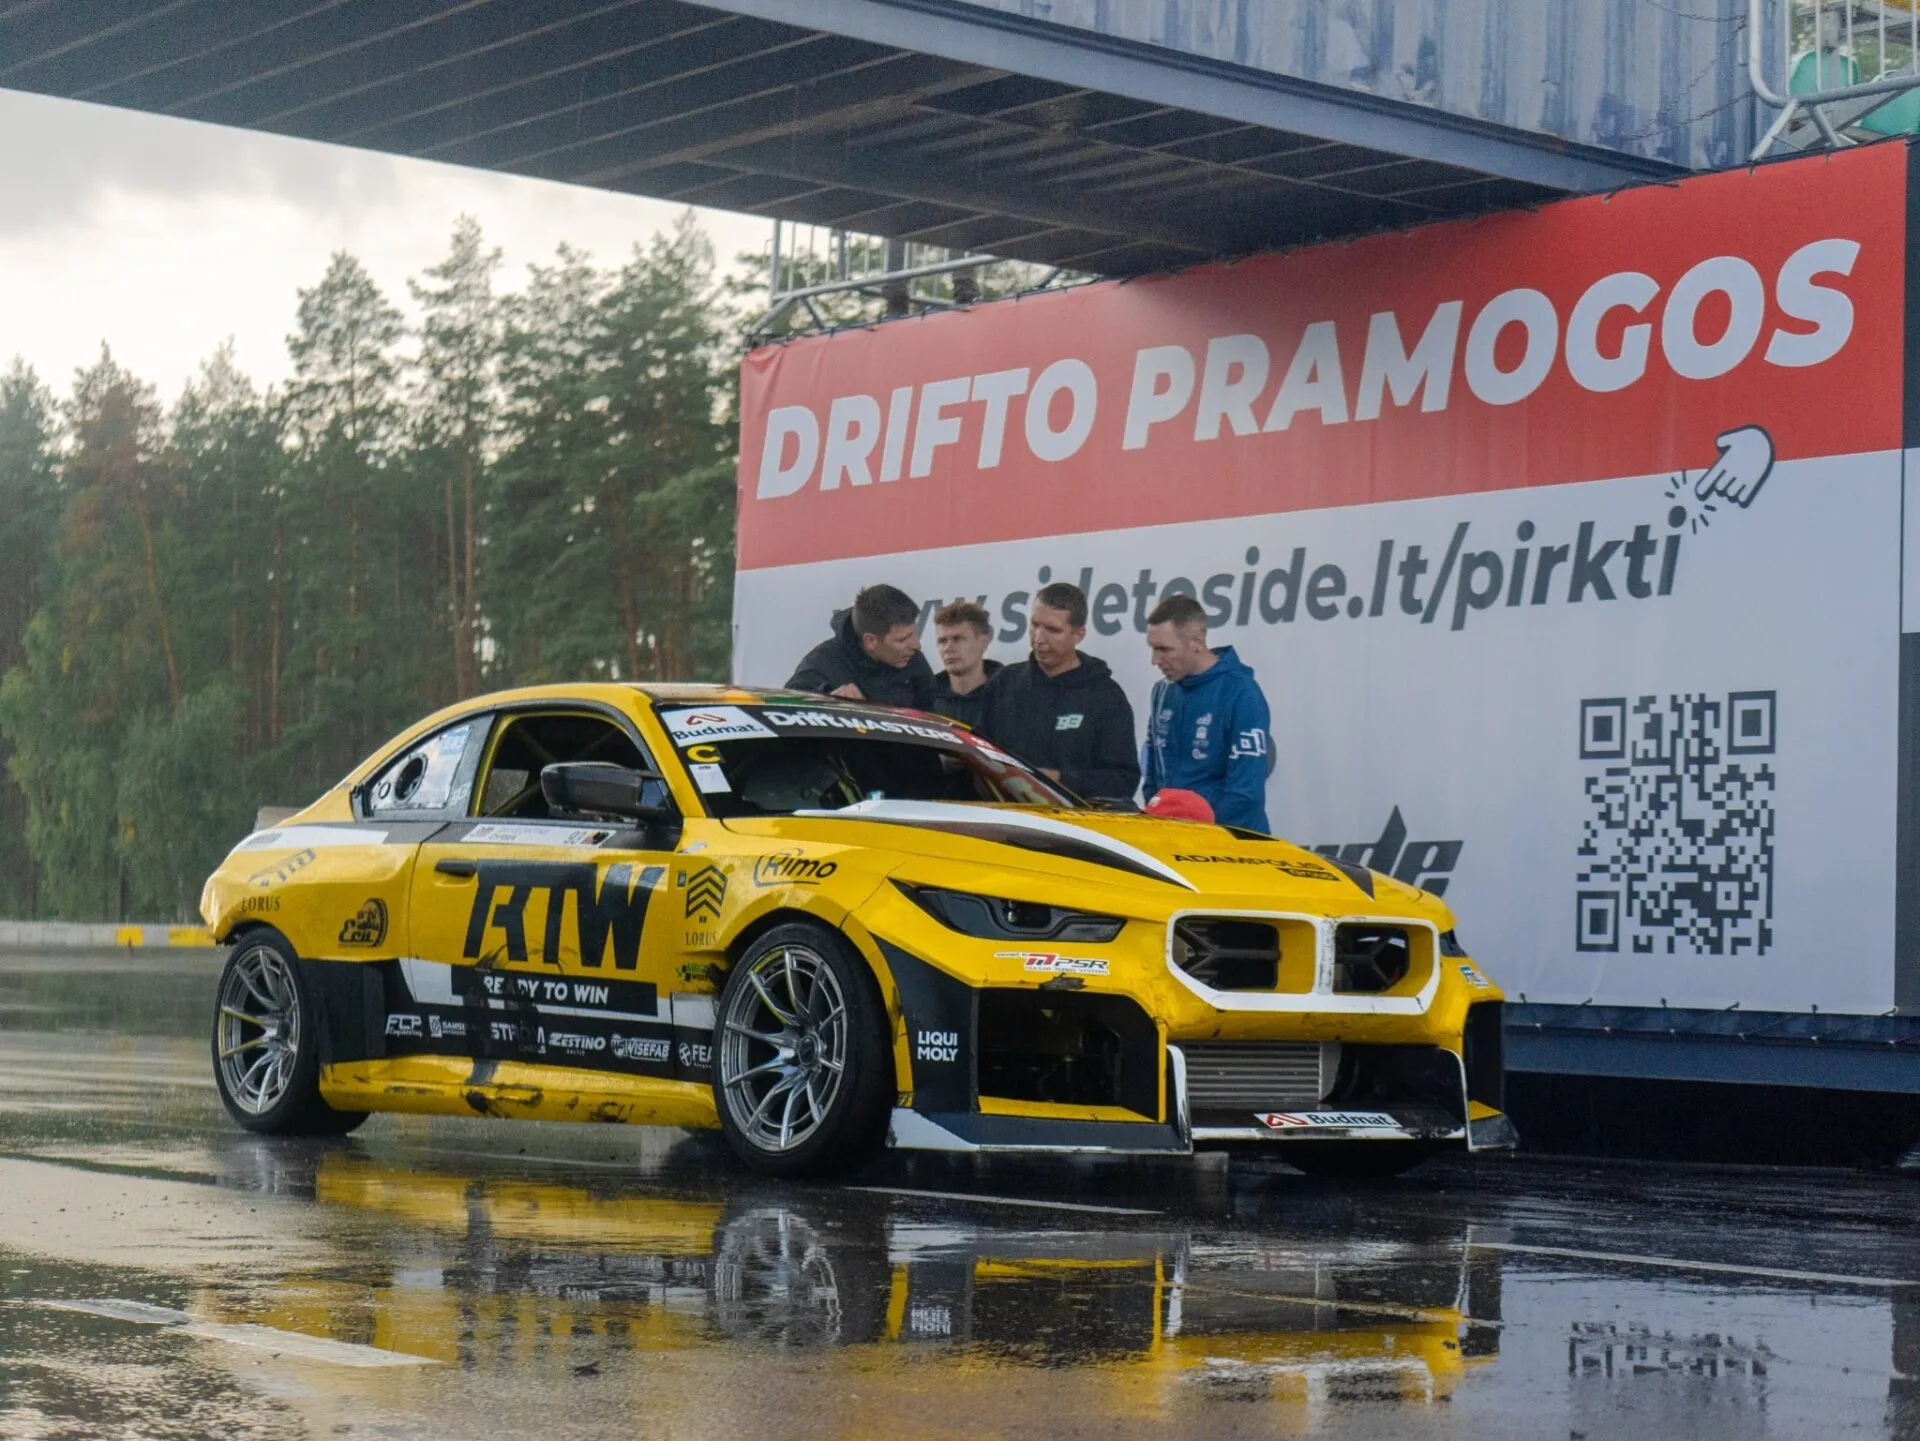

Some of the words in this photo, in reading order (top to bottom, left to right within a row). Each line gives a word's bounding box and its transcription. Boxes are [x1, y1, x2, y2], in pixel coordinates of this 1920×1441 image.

[756, 358, 1098, 499] DRIFTO
[1121, 238, 1861, 452] PRAMOGOS
[686, 745, 721, 763] C
[759, 852, 838, 879] Rimo
[241, 896, 281, 913] LORUS
[685, 931, 717, 946] LORUS
[543, 981, 568, 1001] TO
[573, 983, 609, 1005] WIN
[385, 1014, 422, 1034] FCP
[549, 1032, 606, 1051] ZESTINO
[917, 1030, 959, 1046] LIQUI
[625, 1039, 670, 1059] WISEFAB
[916, 1046, 959, 1062] MOLY
